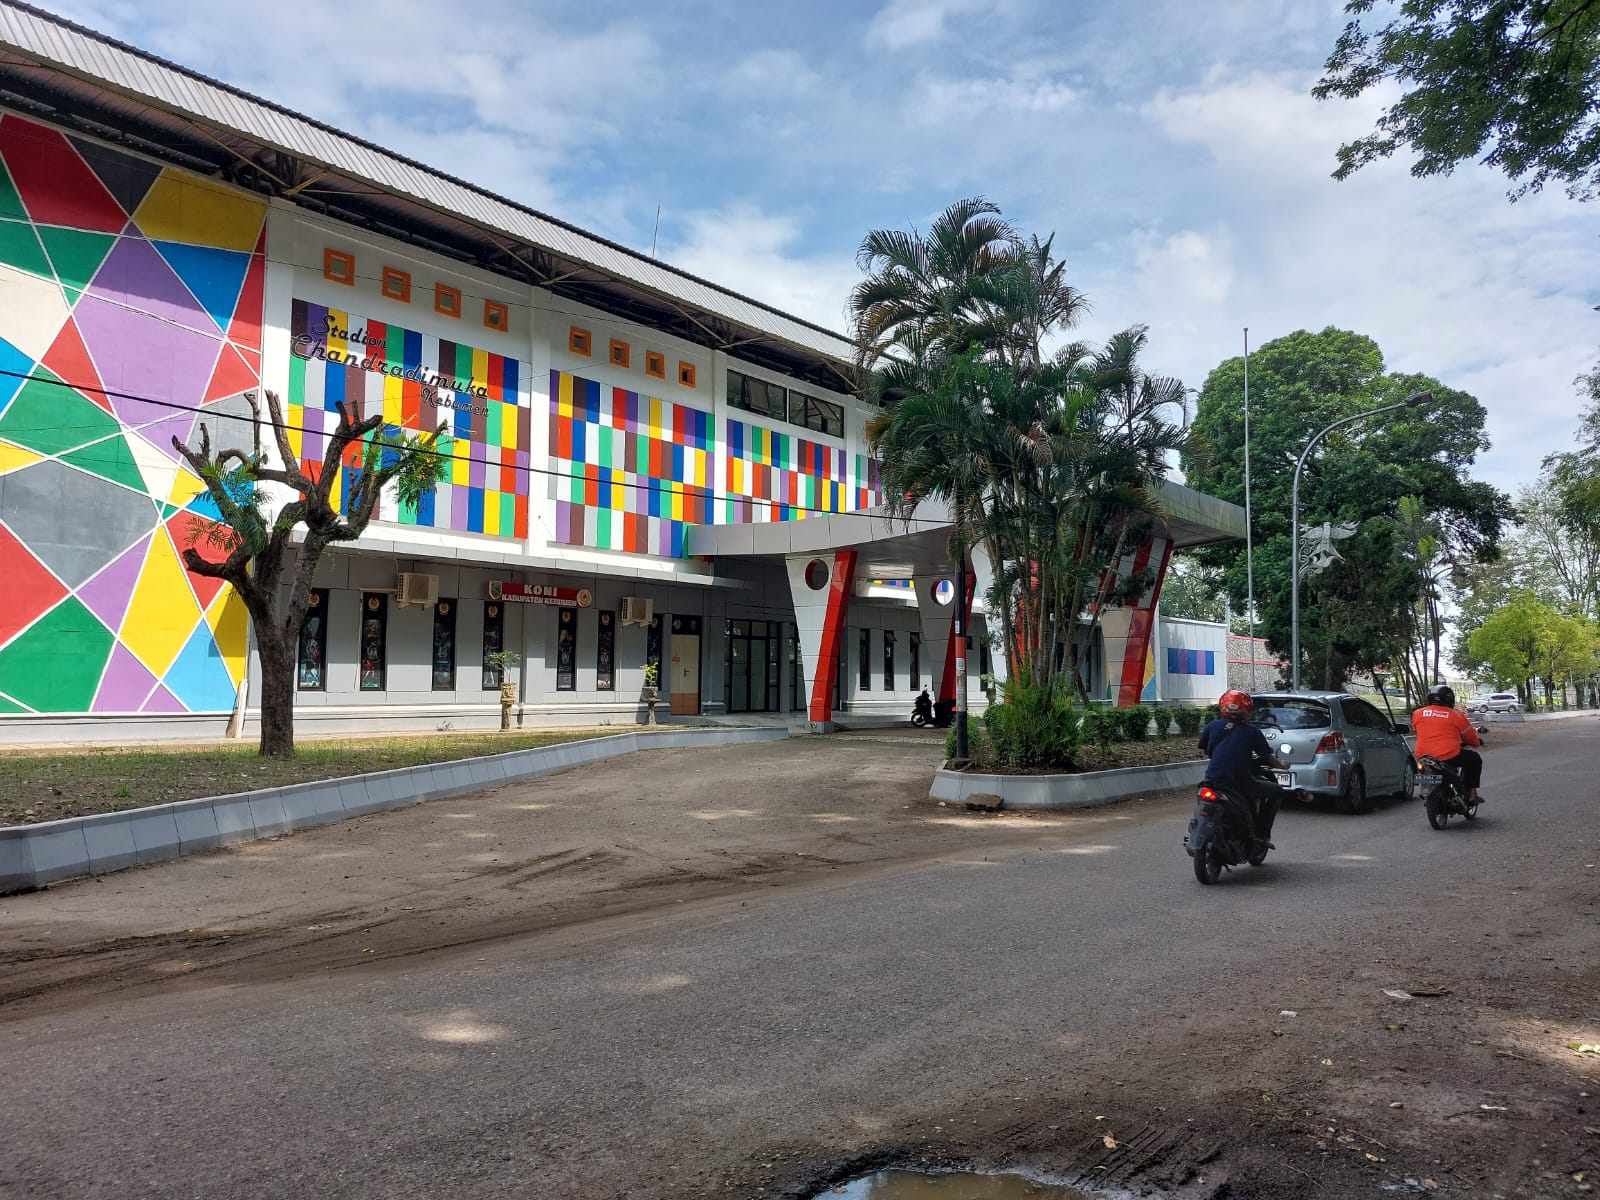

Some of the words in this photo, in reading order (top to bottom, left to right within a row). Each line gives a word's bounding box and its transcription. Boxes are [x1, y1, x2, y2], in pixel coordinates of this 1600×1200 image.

[313, 314, 388, 349] Stadion
[290, 333, 488, 398] Chandradimuka
[421, 388, 489, 416] Kebumen
[501, 594, 543, 604] KABUPATEN
[523, 584, 558, 596] KONI
